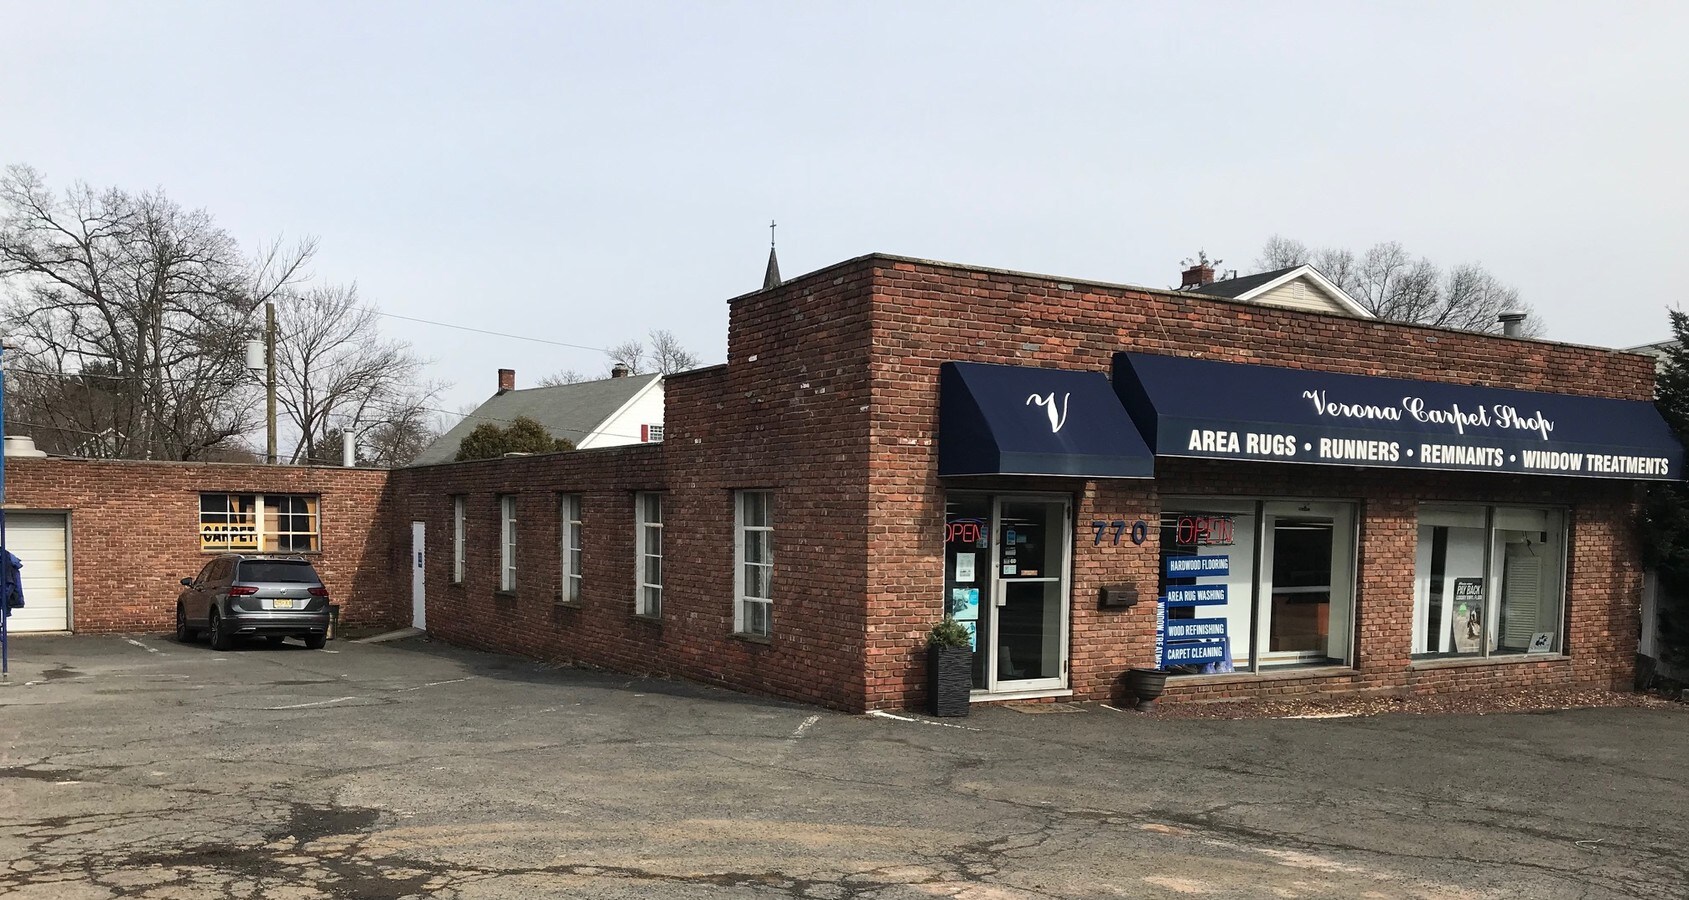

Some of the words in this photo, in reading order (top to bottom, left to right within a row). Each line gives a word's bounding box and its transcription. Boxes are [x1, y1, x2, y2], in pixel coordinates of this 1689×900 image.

[1025, 392, 1070, 433] V
[1303, 389, 1402, 422] Verona
[1402, 396, 1491, 434] Carpet
[1493, 404, 1555, 440] Shop
[1188, 429, 1240, 453] AREA
[1246, 433, 1296, 456] RUGS
[1319, 437, 1400, 462] RUNNERS
[1419, 443, 1504, 467] REMNANTS
[1522, 449, 1583, 471] WINDOW
[1586, 453, 1670, 475] TREATMENTS
[945, 523, 982, 543] OPEN
[1093, 520, 1147, 546] 770
[1178, 517, 1233, 545] OPEN
[1170, 559, 1201, 571] HARDWOOD
[1202, 558, 1228, 570] FLOORING
[1168, 591, 1184, 602] AREA
[1184, 591, 1196, 601] RUG
[1197, 590, 1224, 600] WASHING
[1457, 585, 1467, 595] PAY
[1467, 585, 1481, 595] BACK
[1157, 602, 1165, 631] WINDOW
[1169, 625, 1184, 636] WOOD
[1185, 623, 1224, 635] REFINISHING
[1168, 648, 1190, 660] CARPET
[1192, 646, 1222, 658] CLEANING
